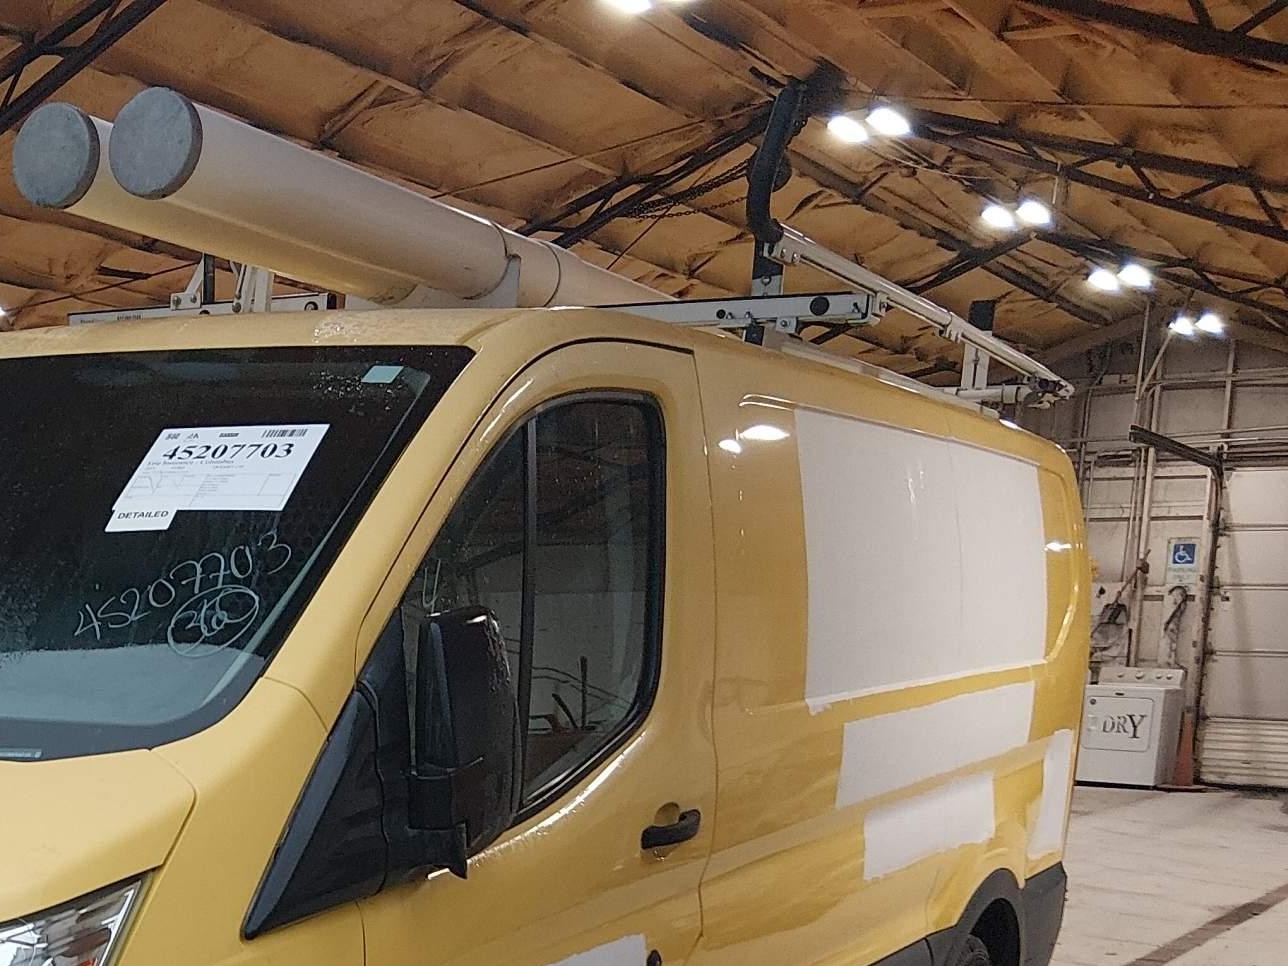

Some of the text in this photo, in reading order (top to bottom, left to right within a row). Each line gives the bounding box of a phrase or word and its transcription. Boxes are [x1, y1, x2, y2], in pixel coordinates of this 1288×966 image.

[162, 442, 295, 460] 45207703
[117, 509, 169, 520] DETAILED
[74, 530, 292, 641] 45207703
[1102, 713, 1148, 739] DRY
